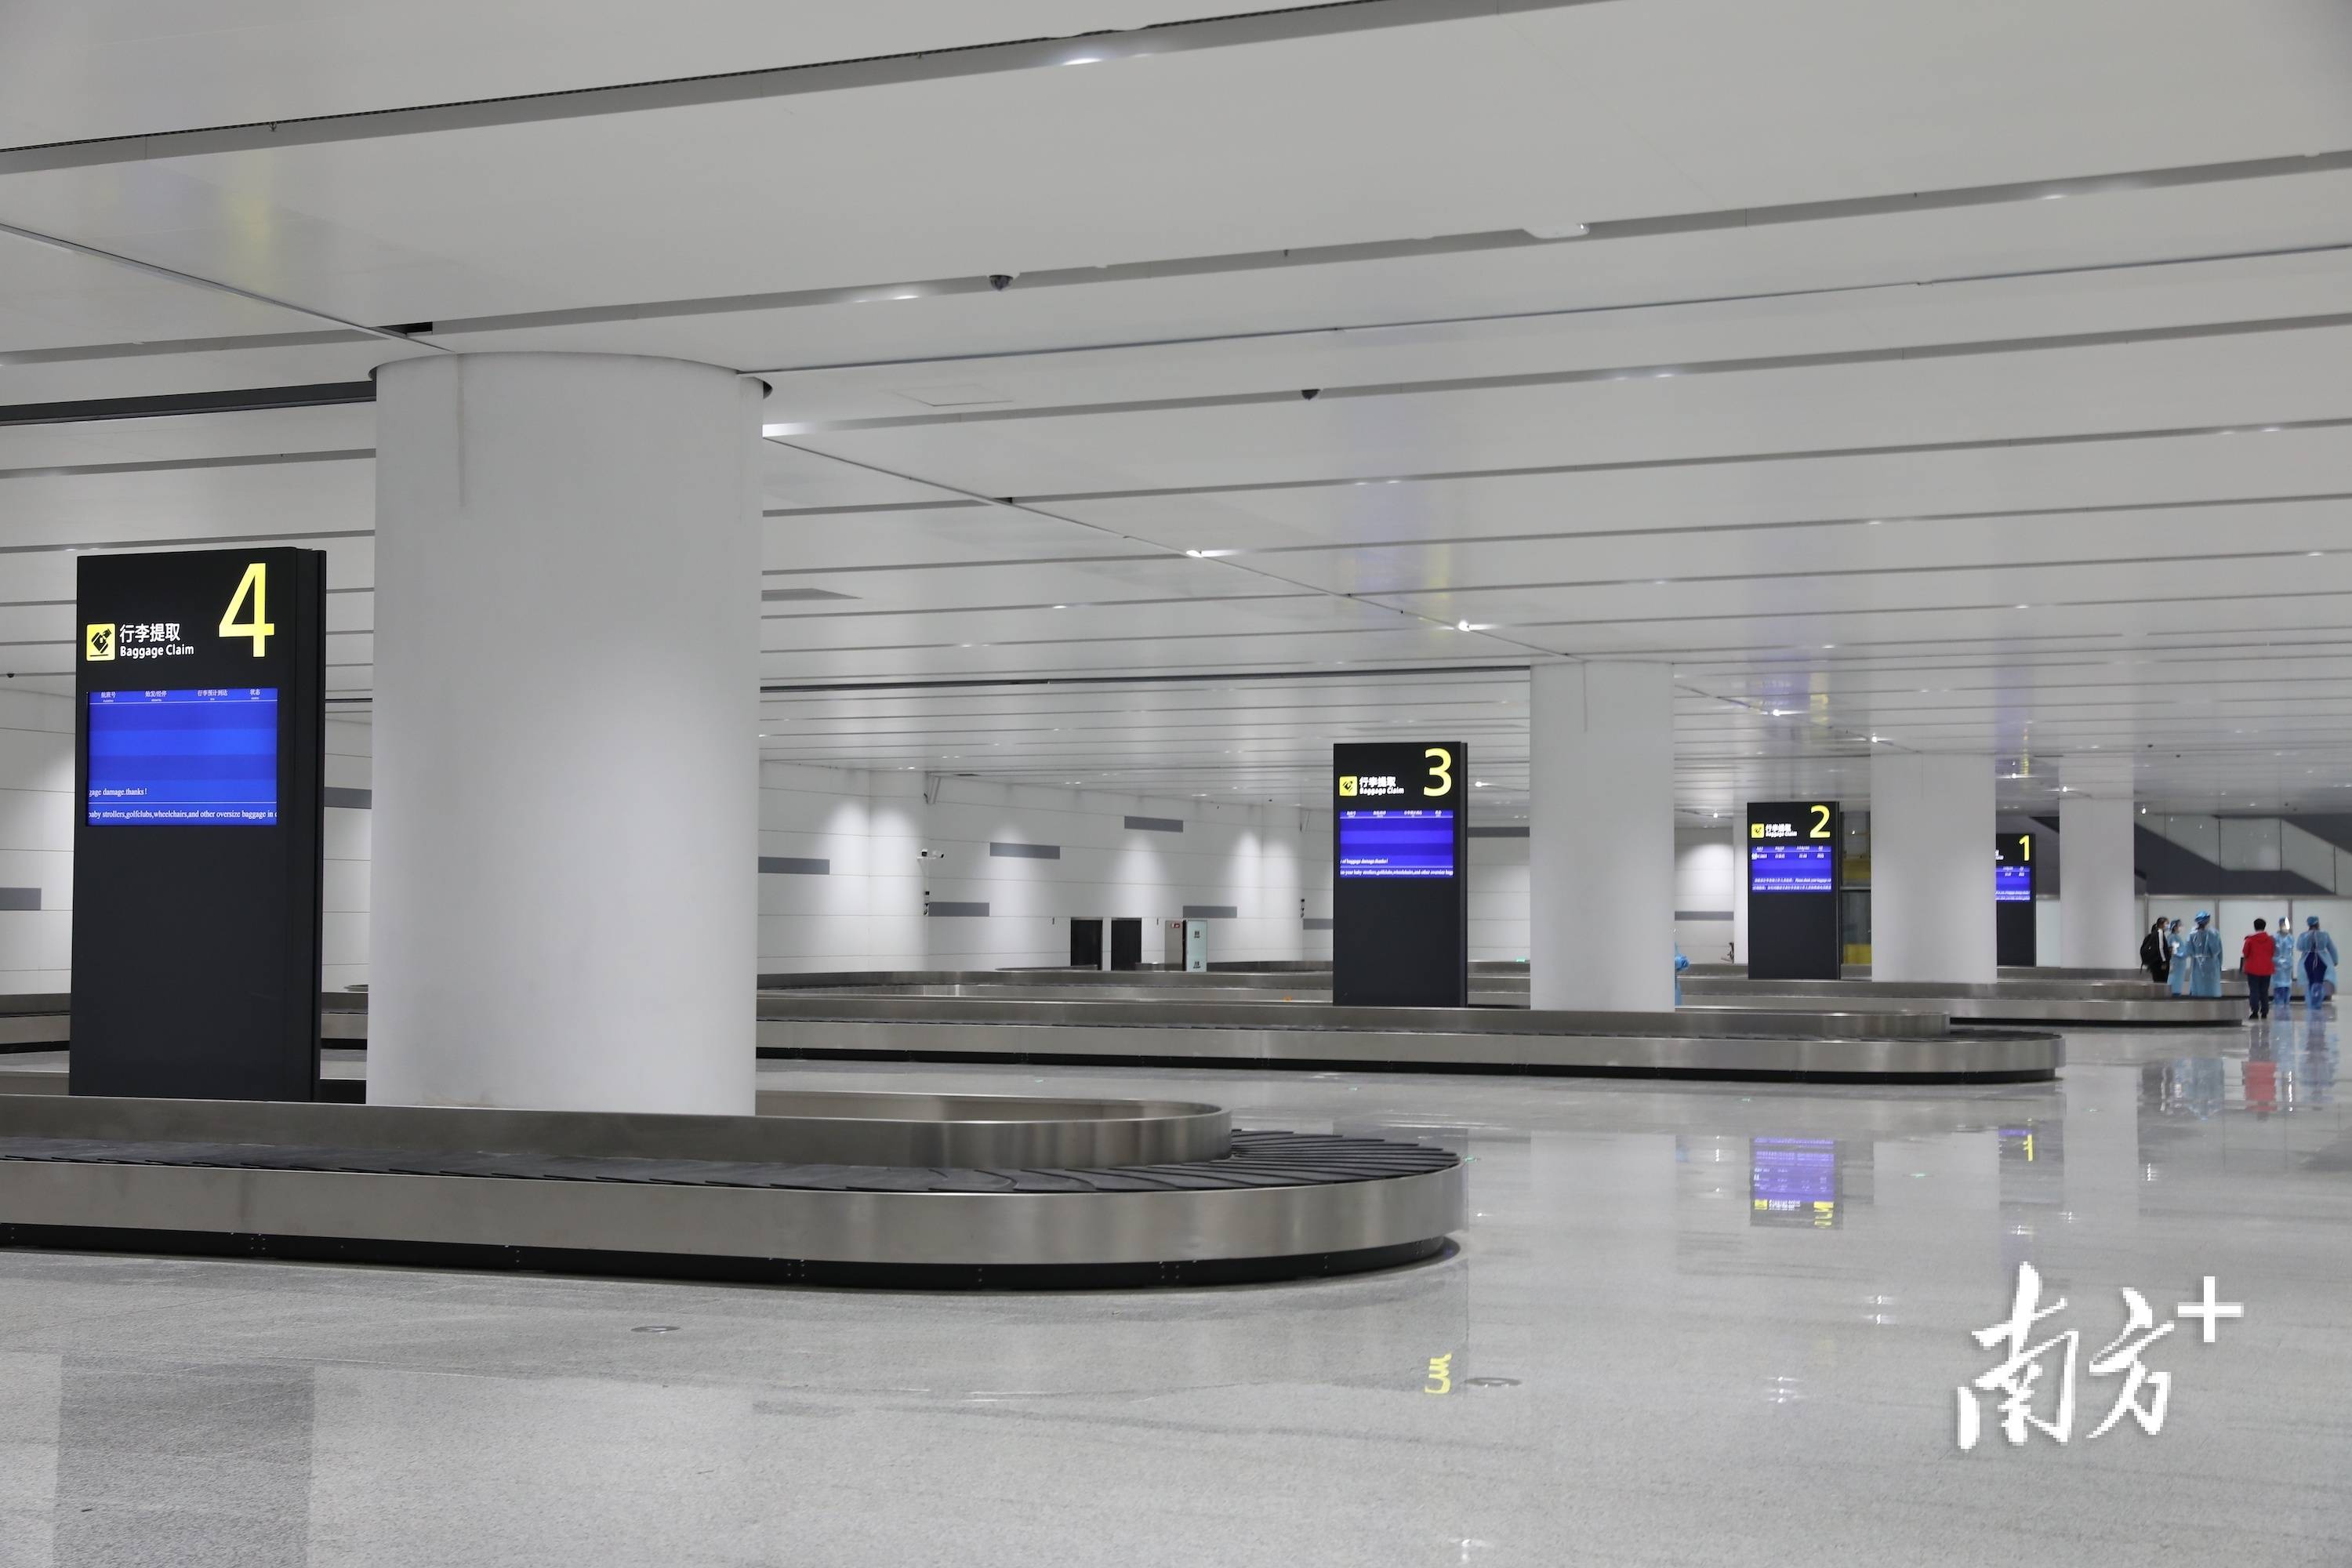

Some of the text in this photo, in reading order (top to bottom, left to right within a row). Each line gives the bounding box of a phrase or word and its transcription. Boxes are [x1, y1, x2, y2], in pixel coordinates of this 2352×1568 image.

[219, 563, 274, 657] 4
[119, 623, 180, 643] 行李提取
[120, 644, 194, 659] Baggage Claim
[1423, 748, 1452, 797] 3
[241, 810, 266, 819] baggage
[1809, 804, 1831, 838] 2
[2019, 835, 2030, 861] 1
